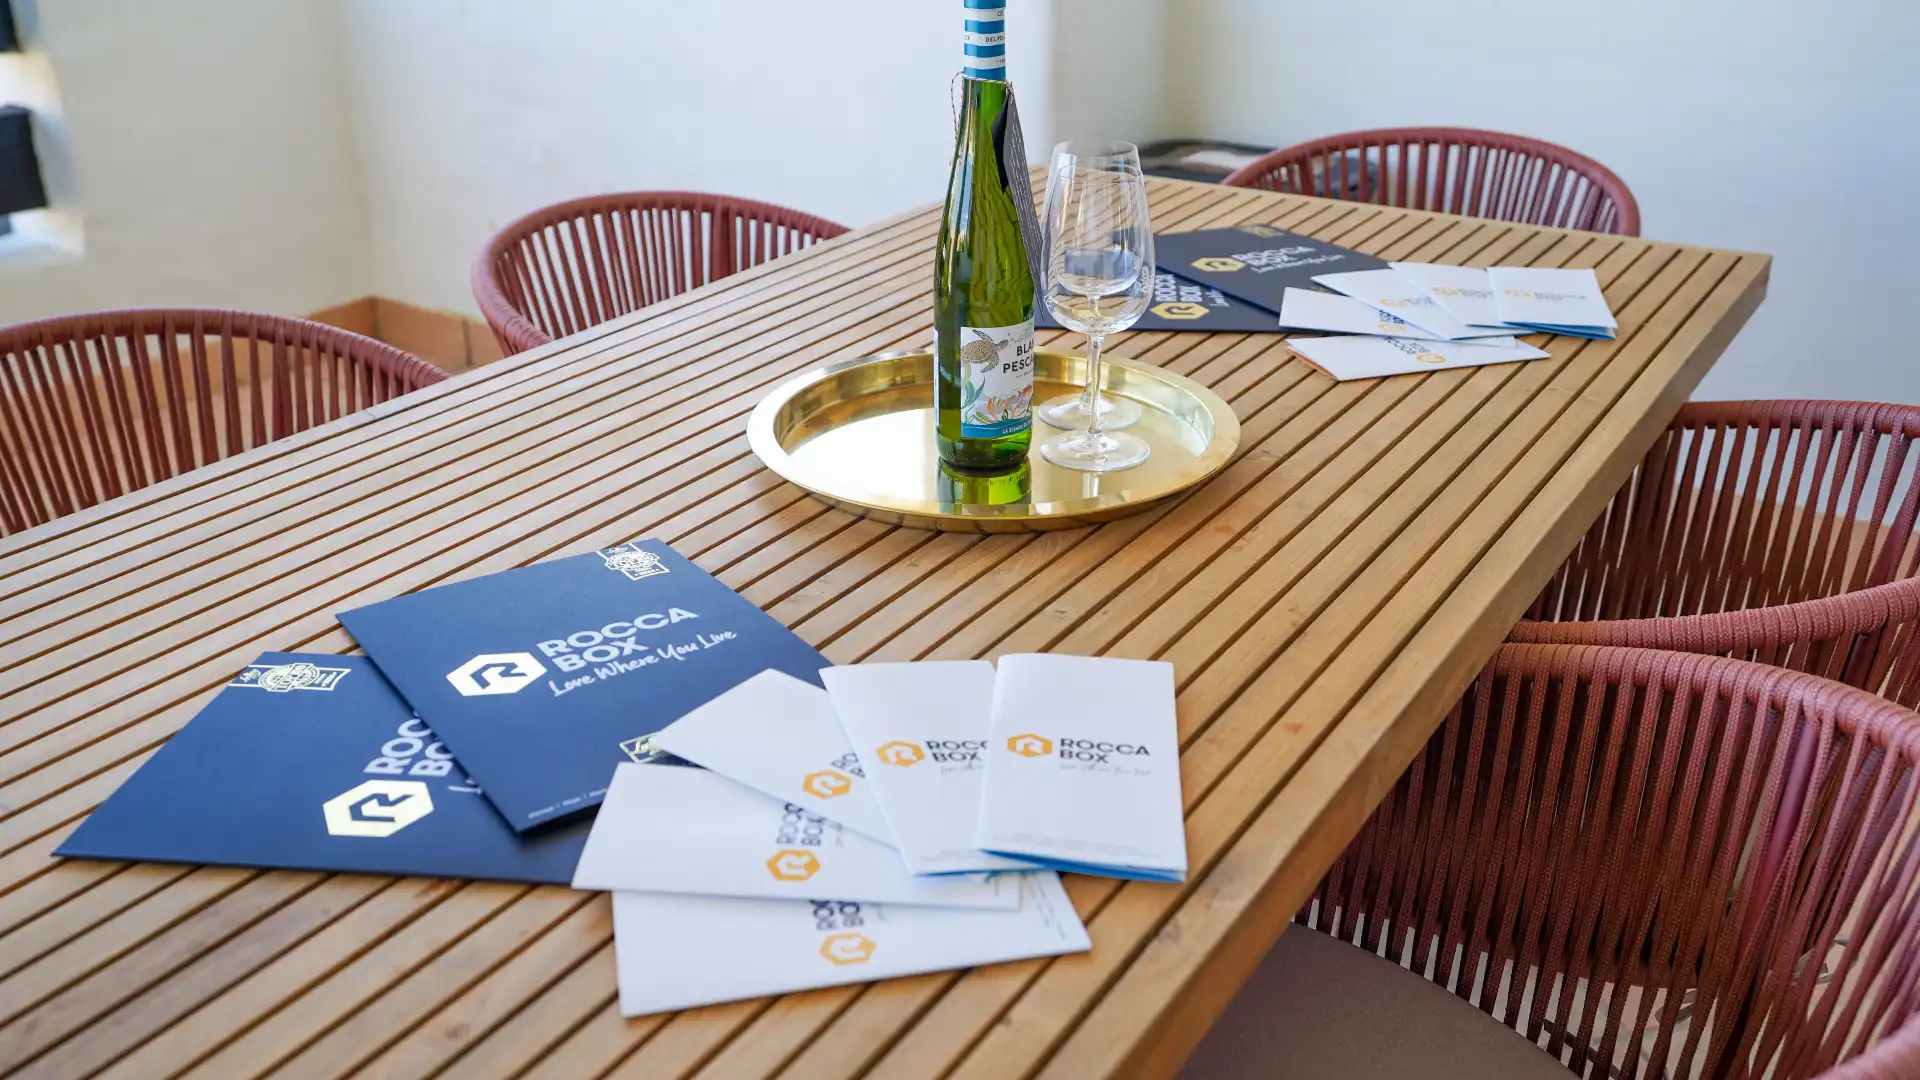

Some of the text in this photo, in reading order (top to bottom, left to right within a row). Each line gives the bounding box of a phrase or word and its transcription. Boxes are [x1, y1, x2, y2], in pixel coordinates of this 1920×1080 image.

[536, 607, 699, 657] ROCCA
[548, 630, 738, 697] Love Where You Live
[552, 636, 651, 672] BOX
[363, 711, 432, 775] ROC
[408, 737, 454, 777] BO
[931, 751, 982, 763] BOX
[1059, 749, 1108, 763] BOX
[1060, 738, 1150, 756] ROCCA
